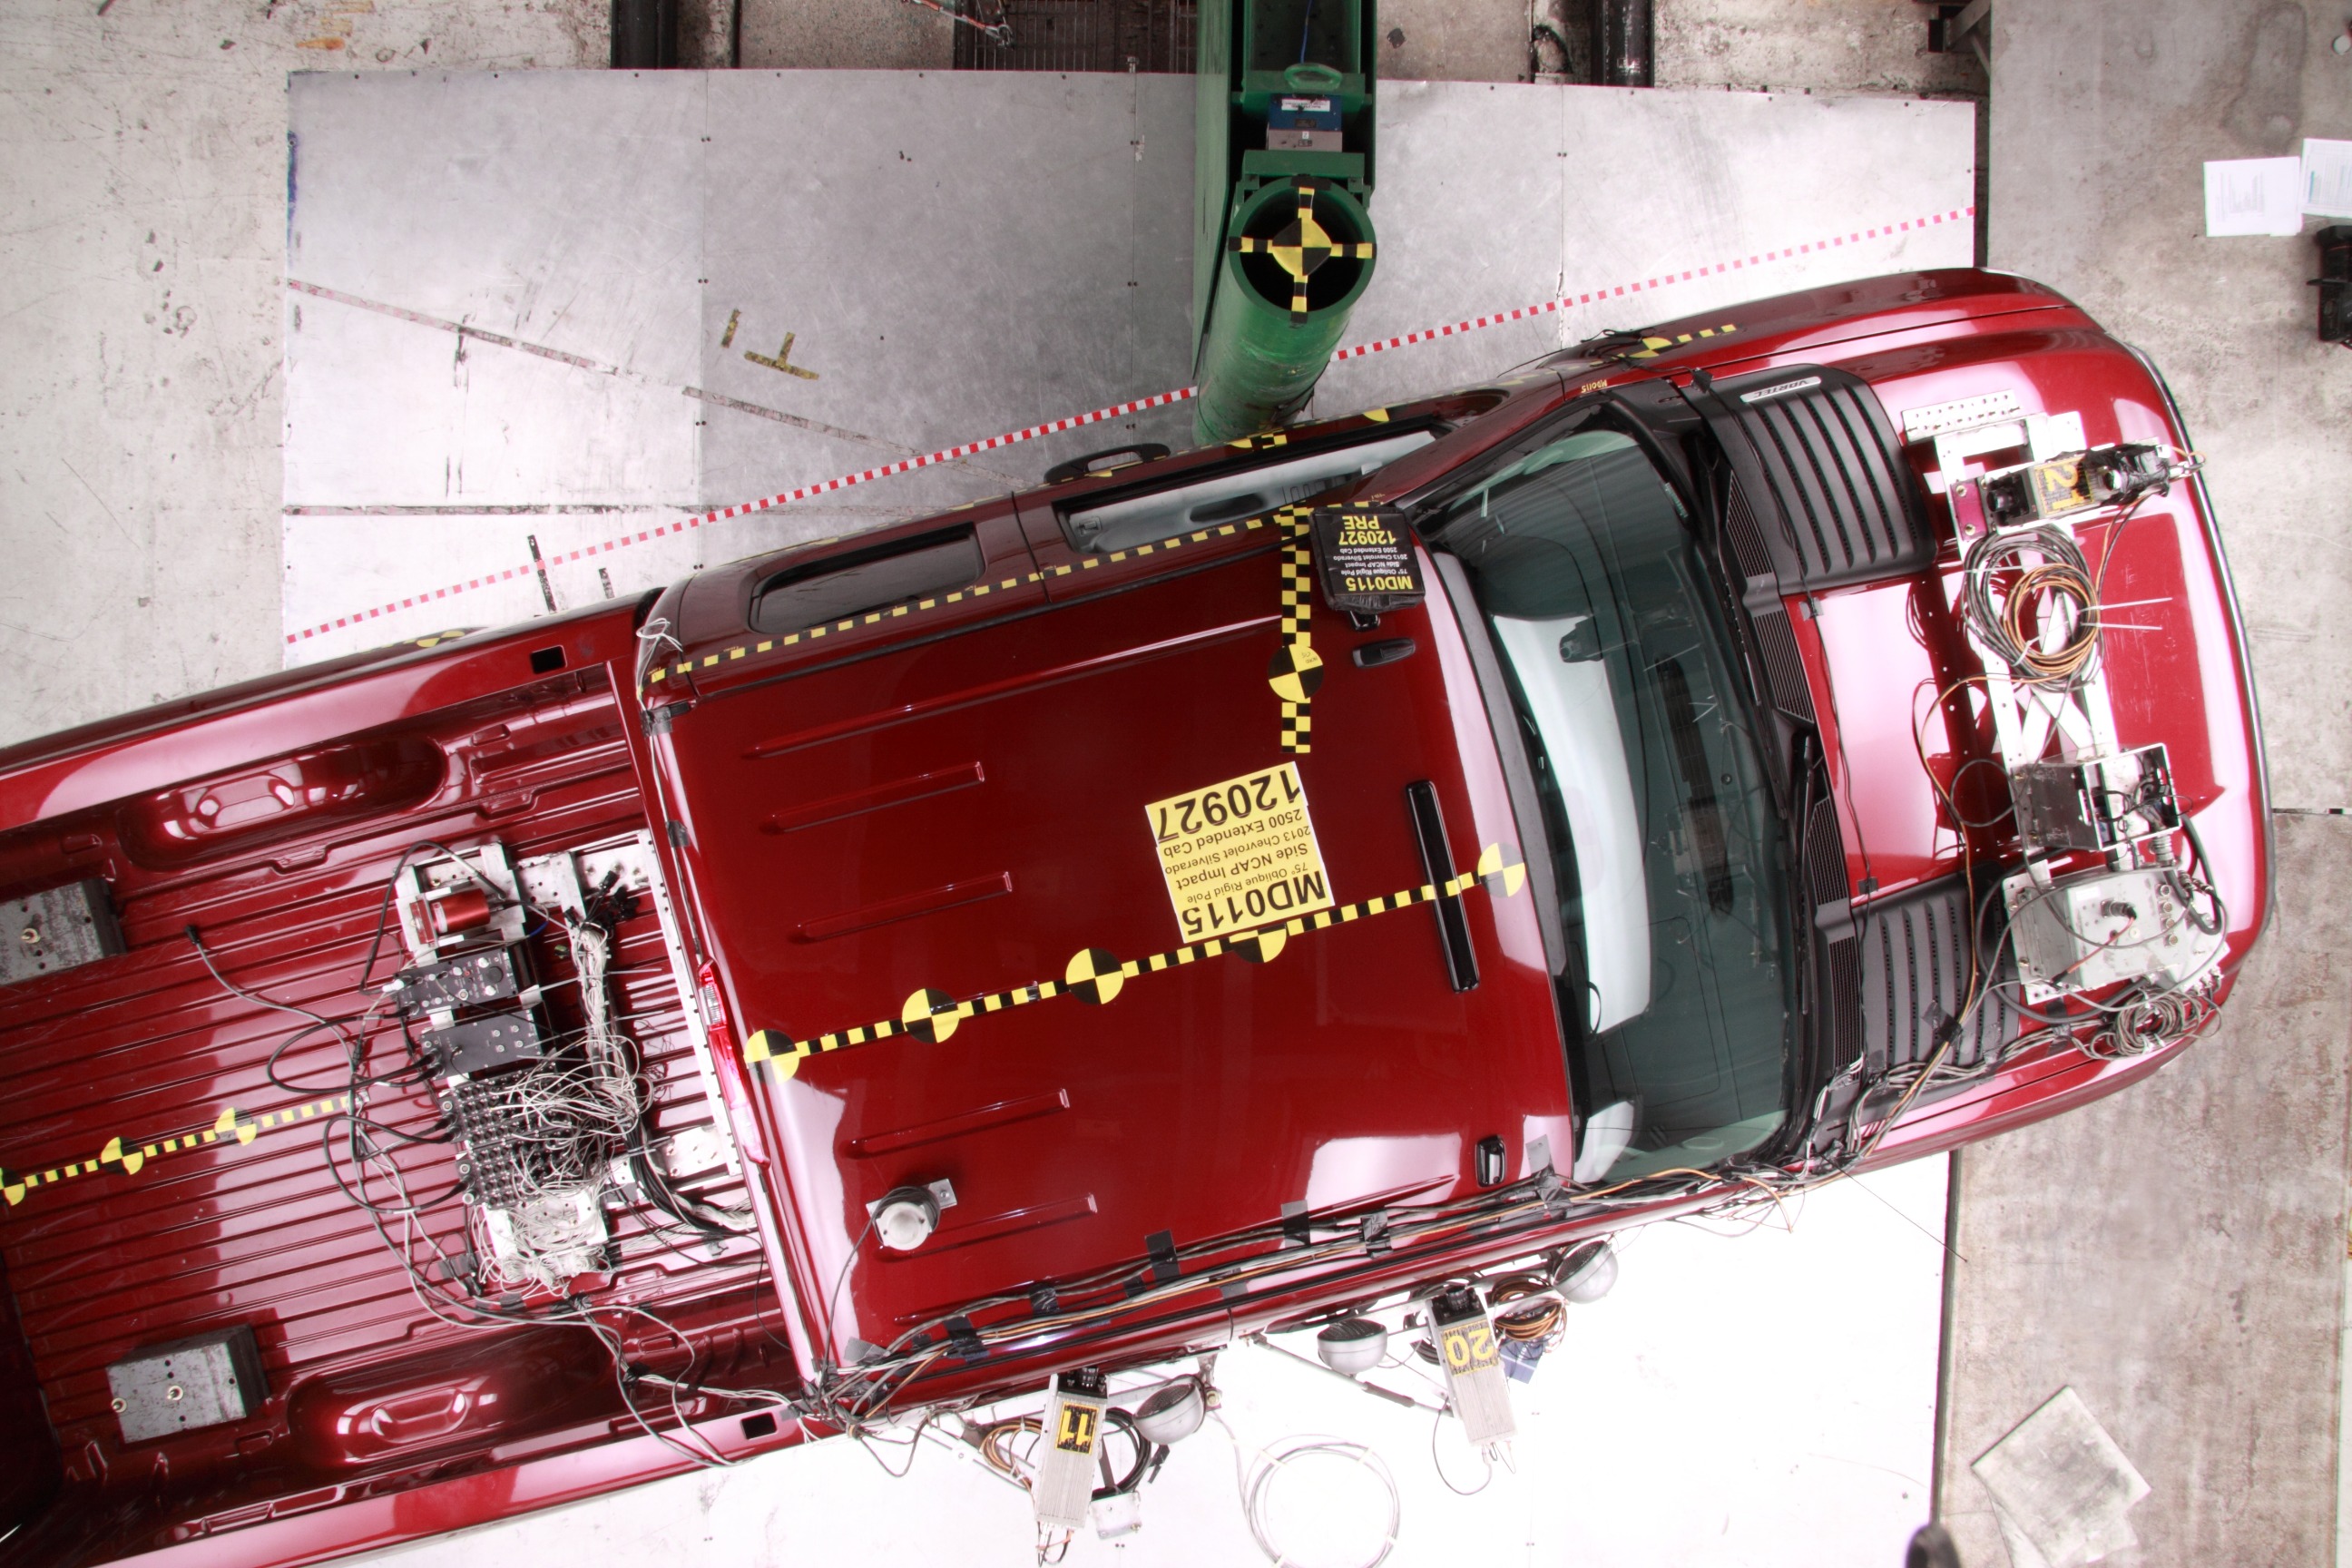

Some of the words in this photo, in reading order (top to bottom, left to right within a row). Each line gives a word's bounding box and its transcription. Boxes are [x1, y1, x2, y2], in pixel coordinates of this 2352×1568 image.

[1753, 380, 1808, 398] VORTEC
[2043, 464, 2085, 510] 21
[1342, 515, 1380, 530] PRE
[1338, 530, 1396, 545] 120927
[1346, 575, 1414, 592] MD0115
[1157, 769, 1301, 843] 120927
[1269, 808, 1303, 828] 2500
[1196, 819, 1265, 849] Extended
[1284, 826, 1311, 841] 2013
[1163, 842, 1192, 858] Cab
[1224, 835, 1280, 858] Chevrolet
[1276, 843, 1308, 858] Side
[1165, 852, 1220, 875] Silverado
[1230, 853, 1273, 876] NCAP
[1176, 867, 1225, 891] Impact
[1246, 867, 1288, 887] Oblique
[1187, 890, 1211, 903] Pole
[1214, 880, 1243, 897] Rigid
[1181, 870, 1326, 936] MD0115
[1445, 1328, 1494, 1367] 20
[1058, 1410, 1091, 1446] 11
